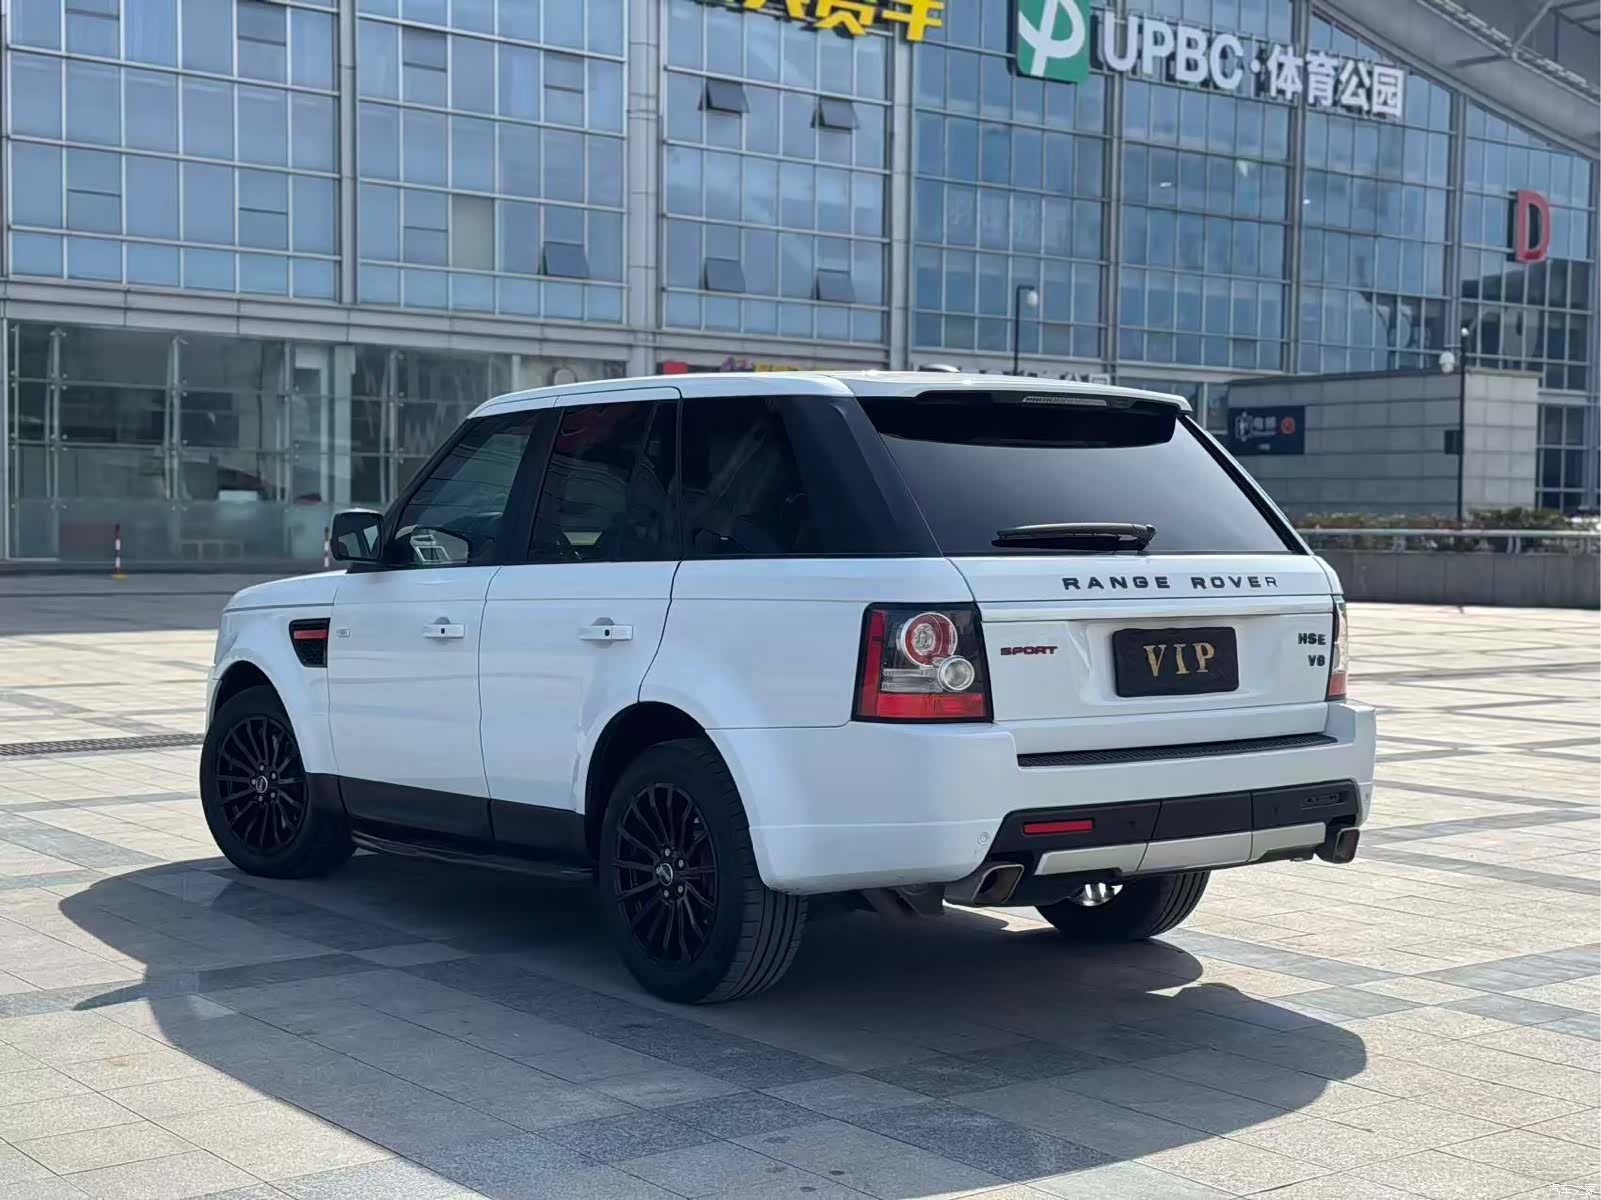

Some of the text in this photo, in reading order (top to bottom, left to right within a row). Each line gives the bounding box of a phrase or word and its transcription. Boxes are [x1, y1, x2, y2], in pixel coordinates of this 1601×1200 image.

[1515, 190, 1551, 262] D
[1061, 575, 1279, 590] RANGE ROVER
[1297, 632, 1327, 646] HSE
[1000, 645, 1058, 656] SPORT
[1143, 641, 1216, 678] VIP
